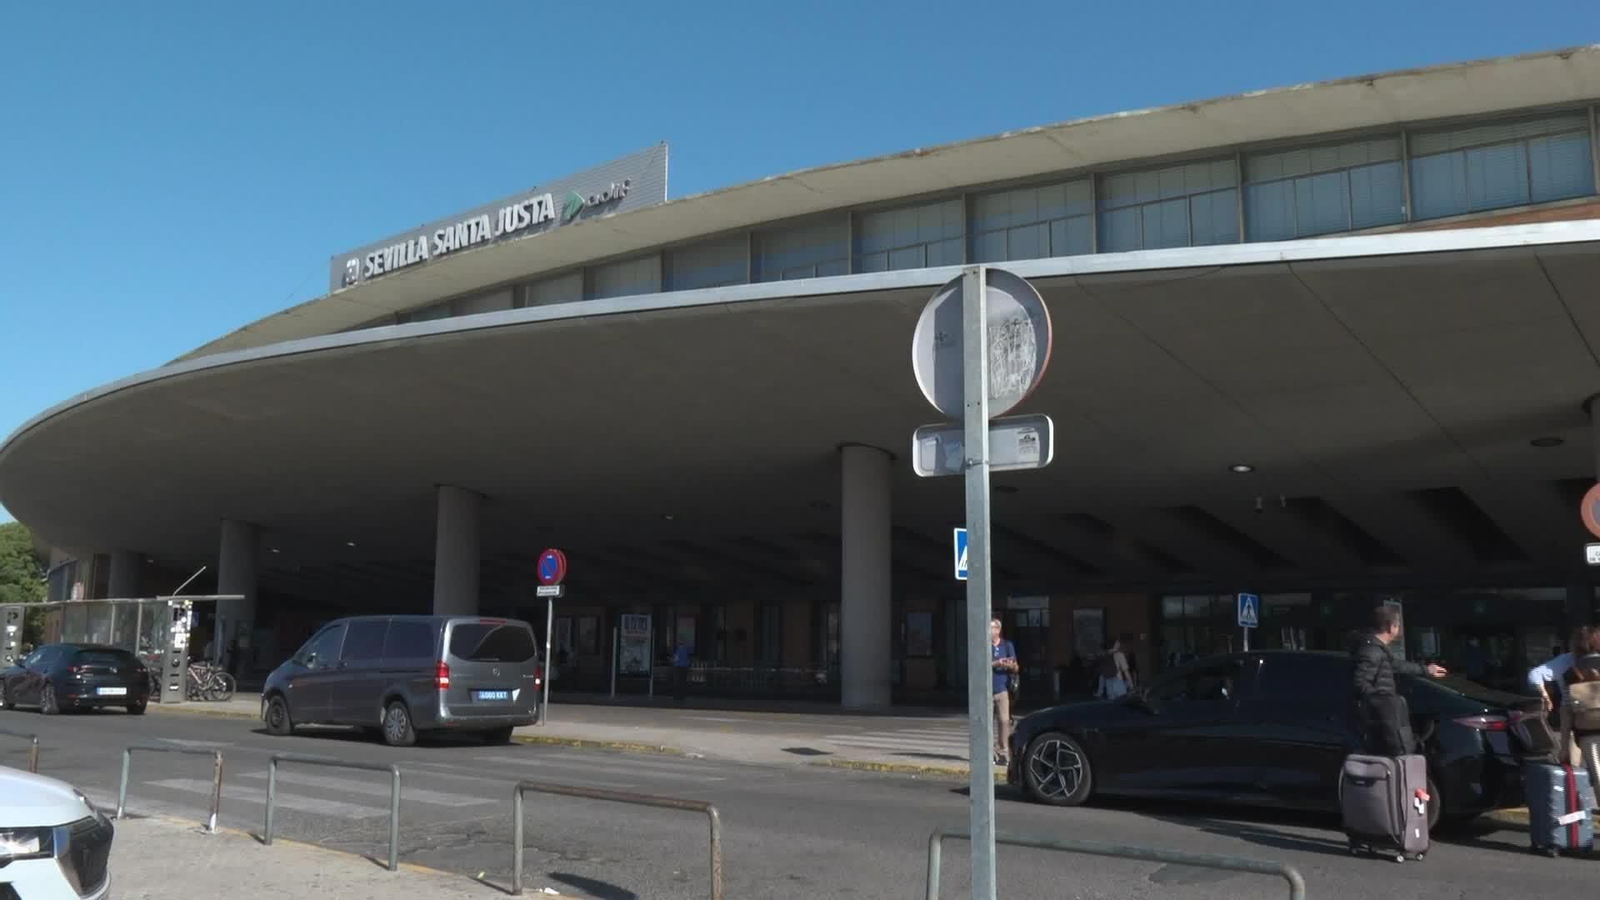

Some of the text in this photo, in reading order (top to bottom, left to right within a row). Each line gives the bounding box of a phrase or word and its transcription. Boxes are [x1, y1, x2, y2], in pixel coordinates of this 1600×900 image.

[364, 192, 556, 277] SEVILLA SANTA JUSTA
